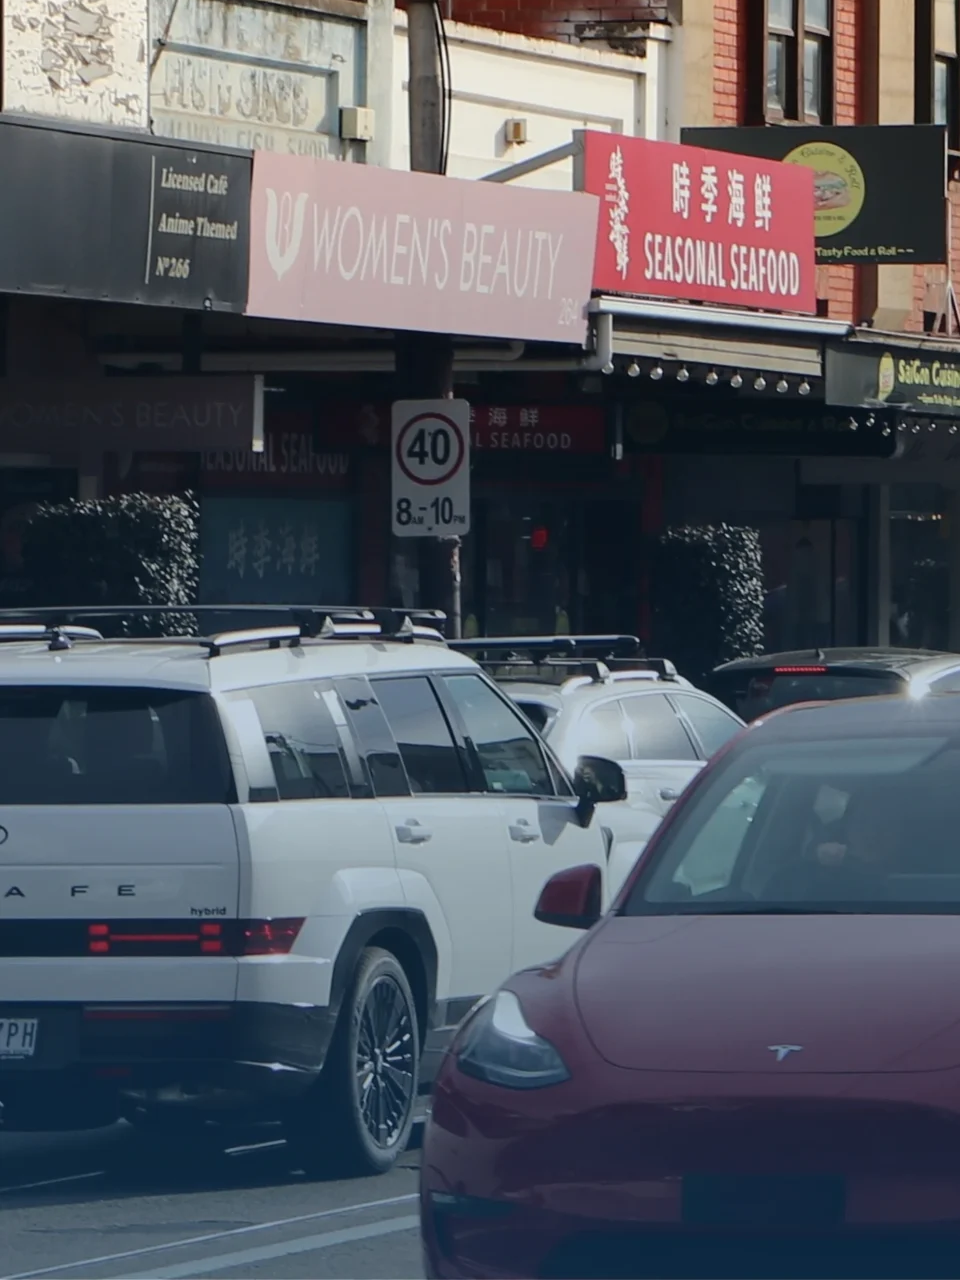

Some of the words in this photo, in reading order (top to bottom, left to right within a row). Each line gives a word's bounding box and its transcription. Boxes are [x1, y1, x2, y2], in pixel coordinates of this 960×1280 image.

[161, 166, 206, 192] Licensed
[672, 161, 773, 232] 時季海鮮
[158, 212, 195, 235] Anime
[196, 216, 238, 240] Themed
[313, 202, 452, 290] WOMEN'S
[460, 222, 564, 300] BEAUTY
[644, 232, 726, 287] SEASONAL
[730, 244, 799, 296] SEAFOOD
[816, 247, 842, 258] Tasty
[844, 246, 868, 256] Food
[878, 246, 896, 256] Roll
[558, 298, 578, 326] 264
[136, 402, 243, 429] BEAUTY
[407, 428, 450, 465] 40
[490, 433, 572, 449] SEAFOOD
[190, 907, 227, 917] hybrid
